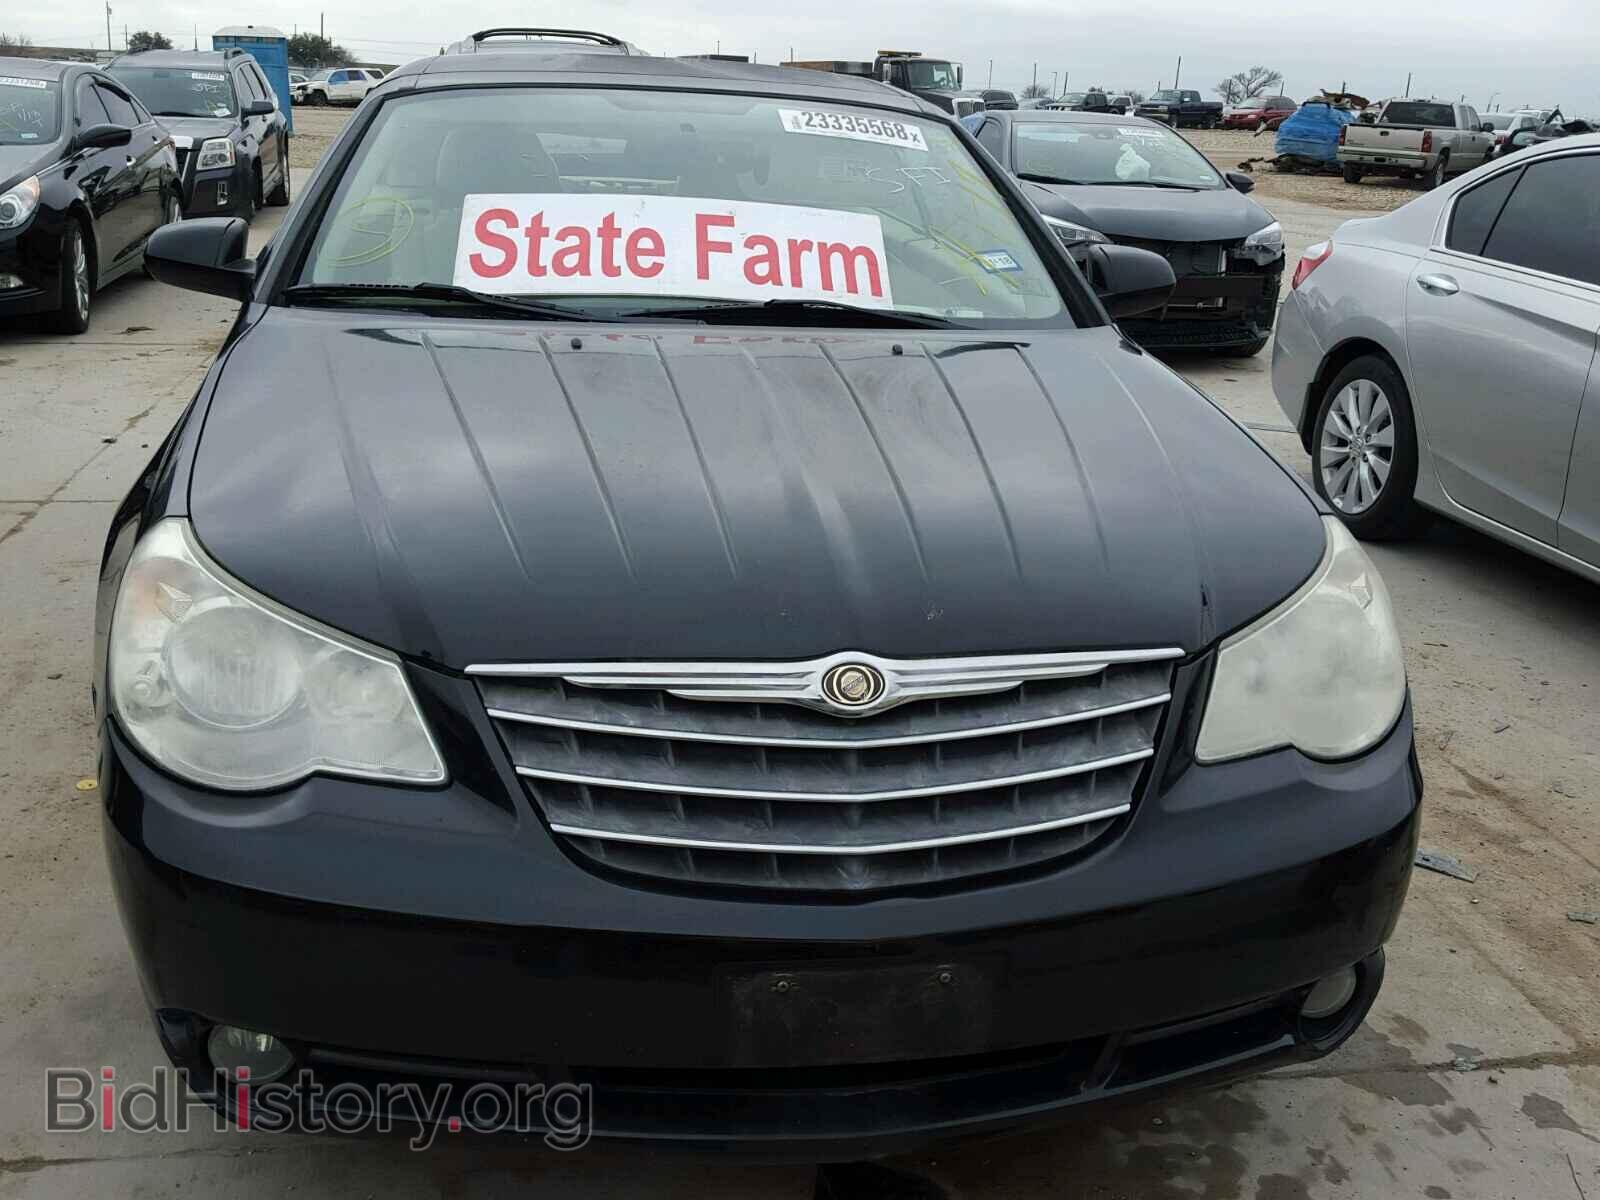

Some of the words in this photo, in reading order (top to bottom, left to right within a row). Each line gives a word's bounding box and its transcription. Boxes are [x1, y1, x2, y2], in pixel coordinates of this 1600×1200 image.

[801, 111, 908, 140] 23335568
[468, 207, 666, 279] State
[694, 213, 884, 298] Farm
